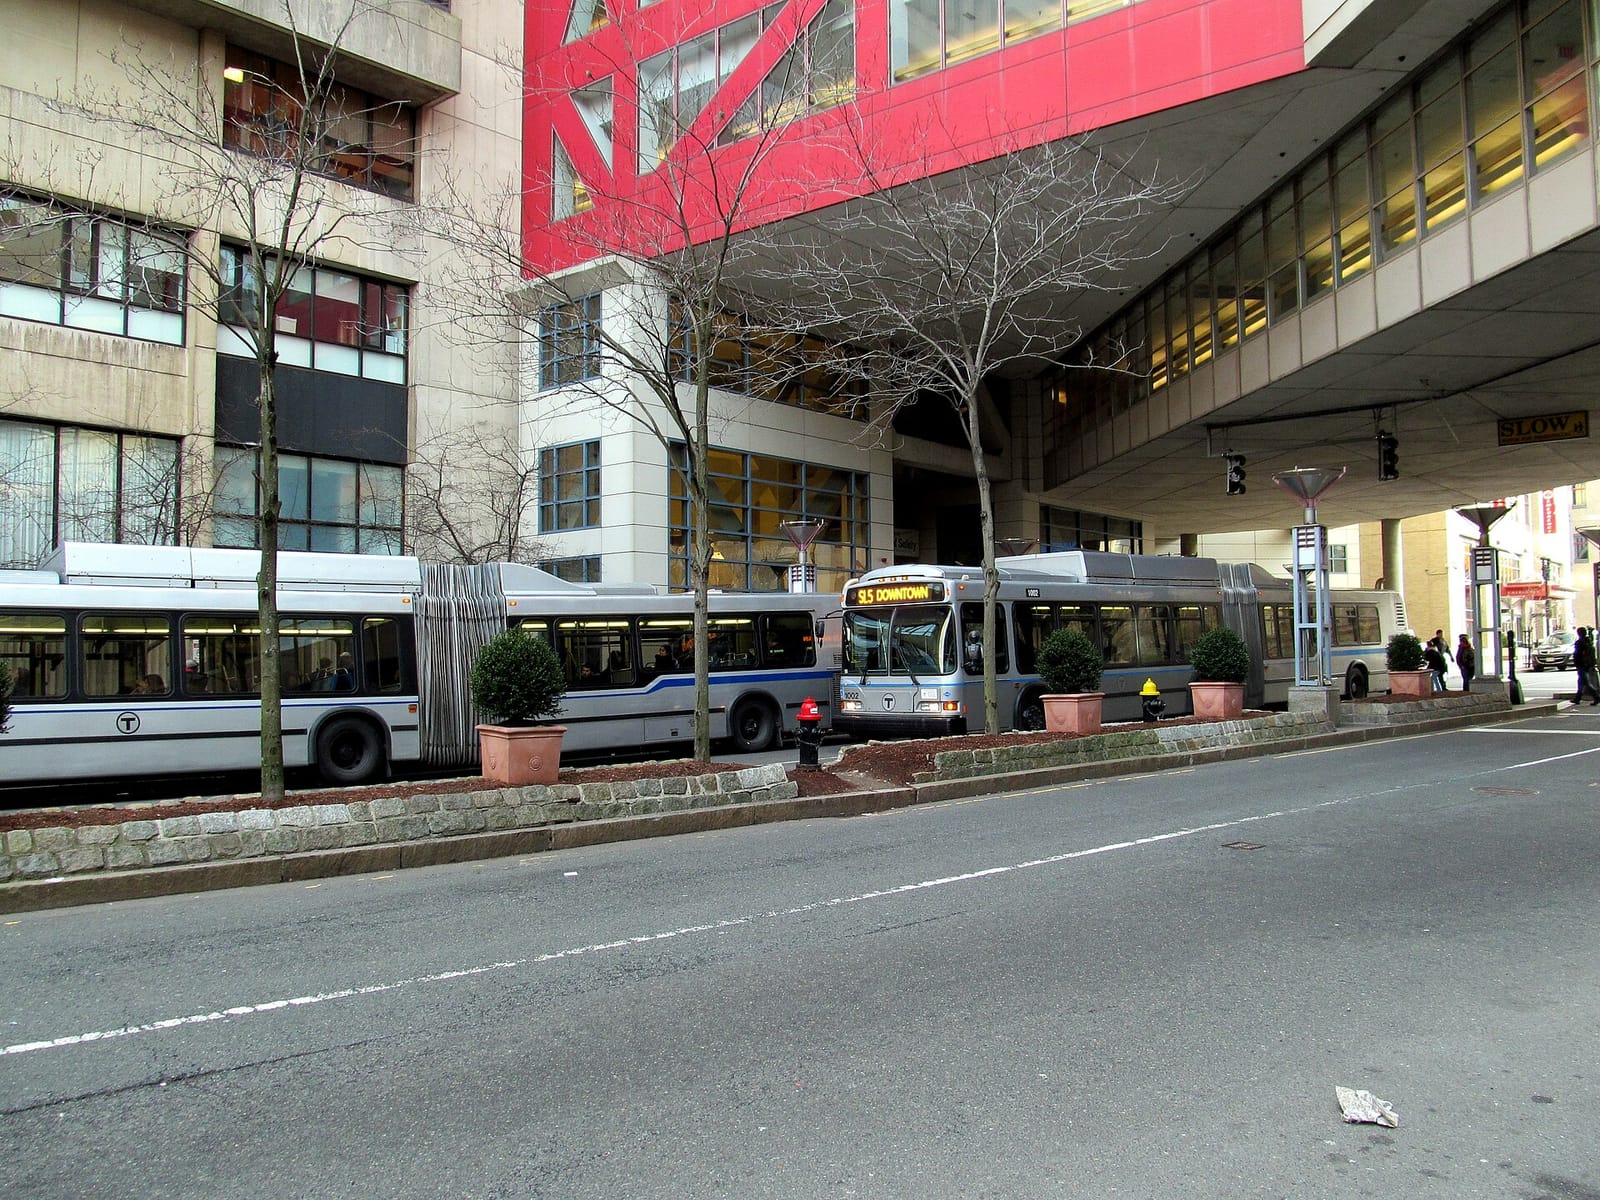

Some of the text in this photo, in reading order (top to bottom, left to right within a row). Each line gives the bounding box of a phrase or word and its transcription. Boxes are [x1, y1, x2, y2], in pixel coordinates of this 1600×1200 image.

[1501, 416, 1569, 437] SLOW
[858, 586, 929, 604] SL5 DOWNTOWN
[844, 692, 859, 700] 1002
[120, 717, 136, 731] T
